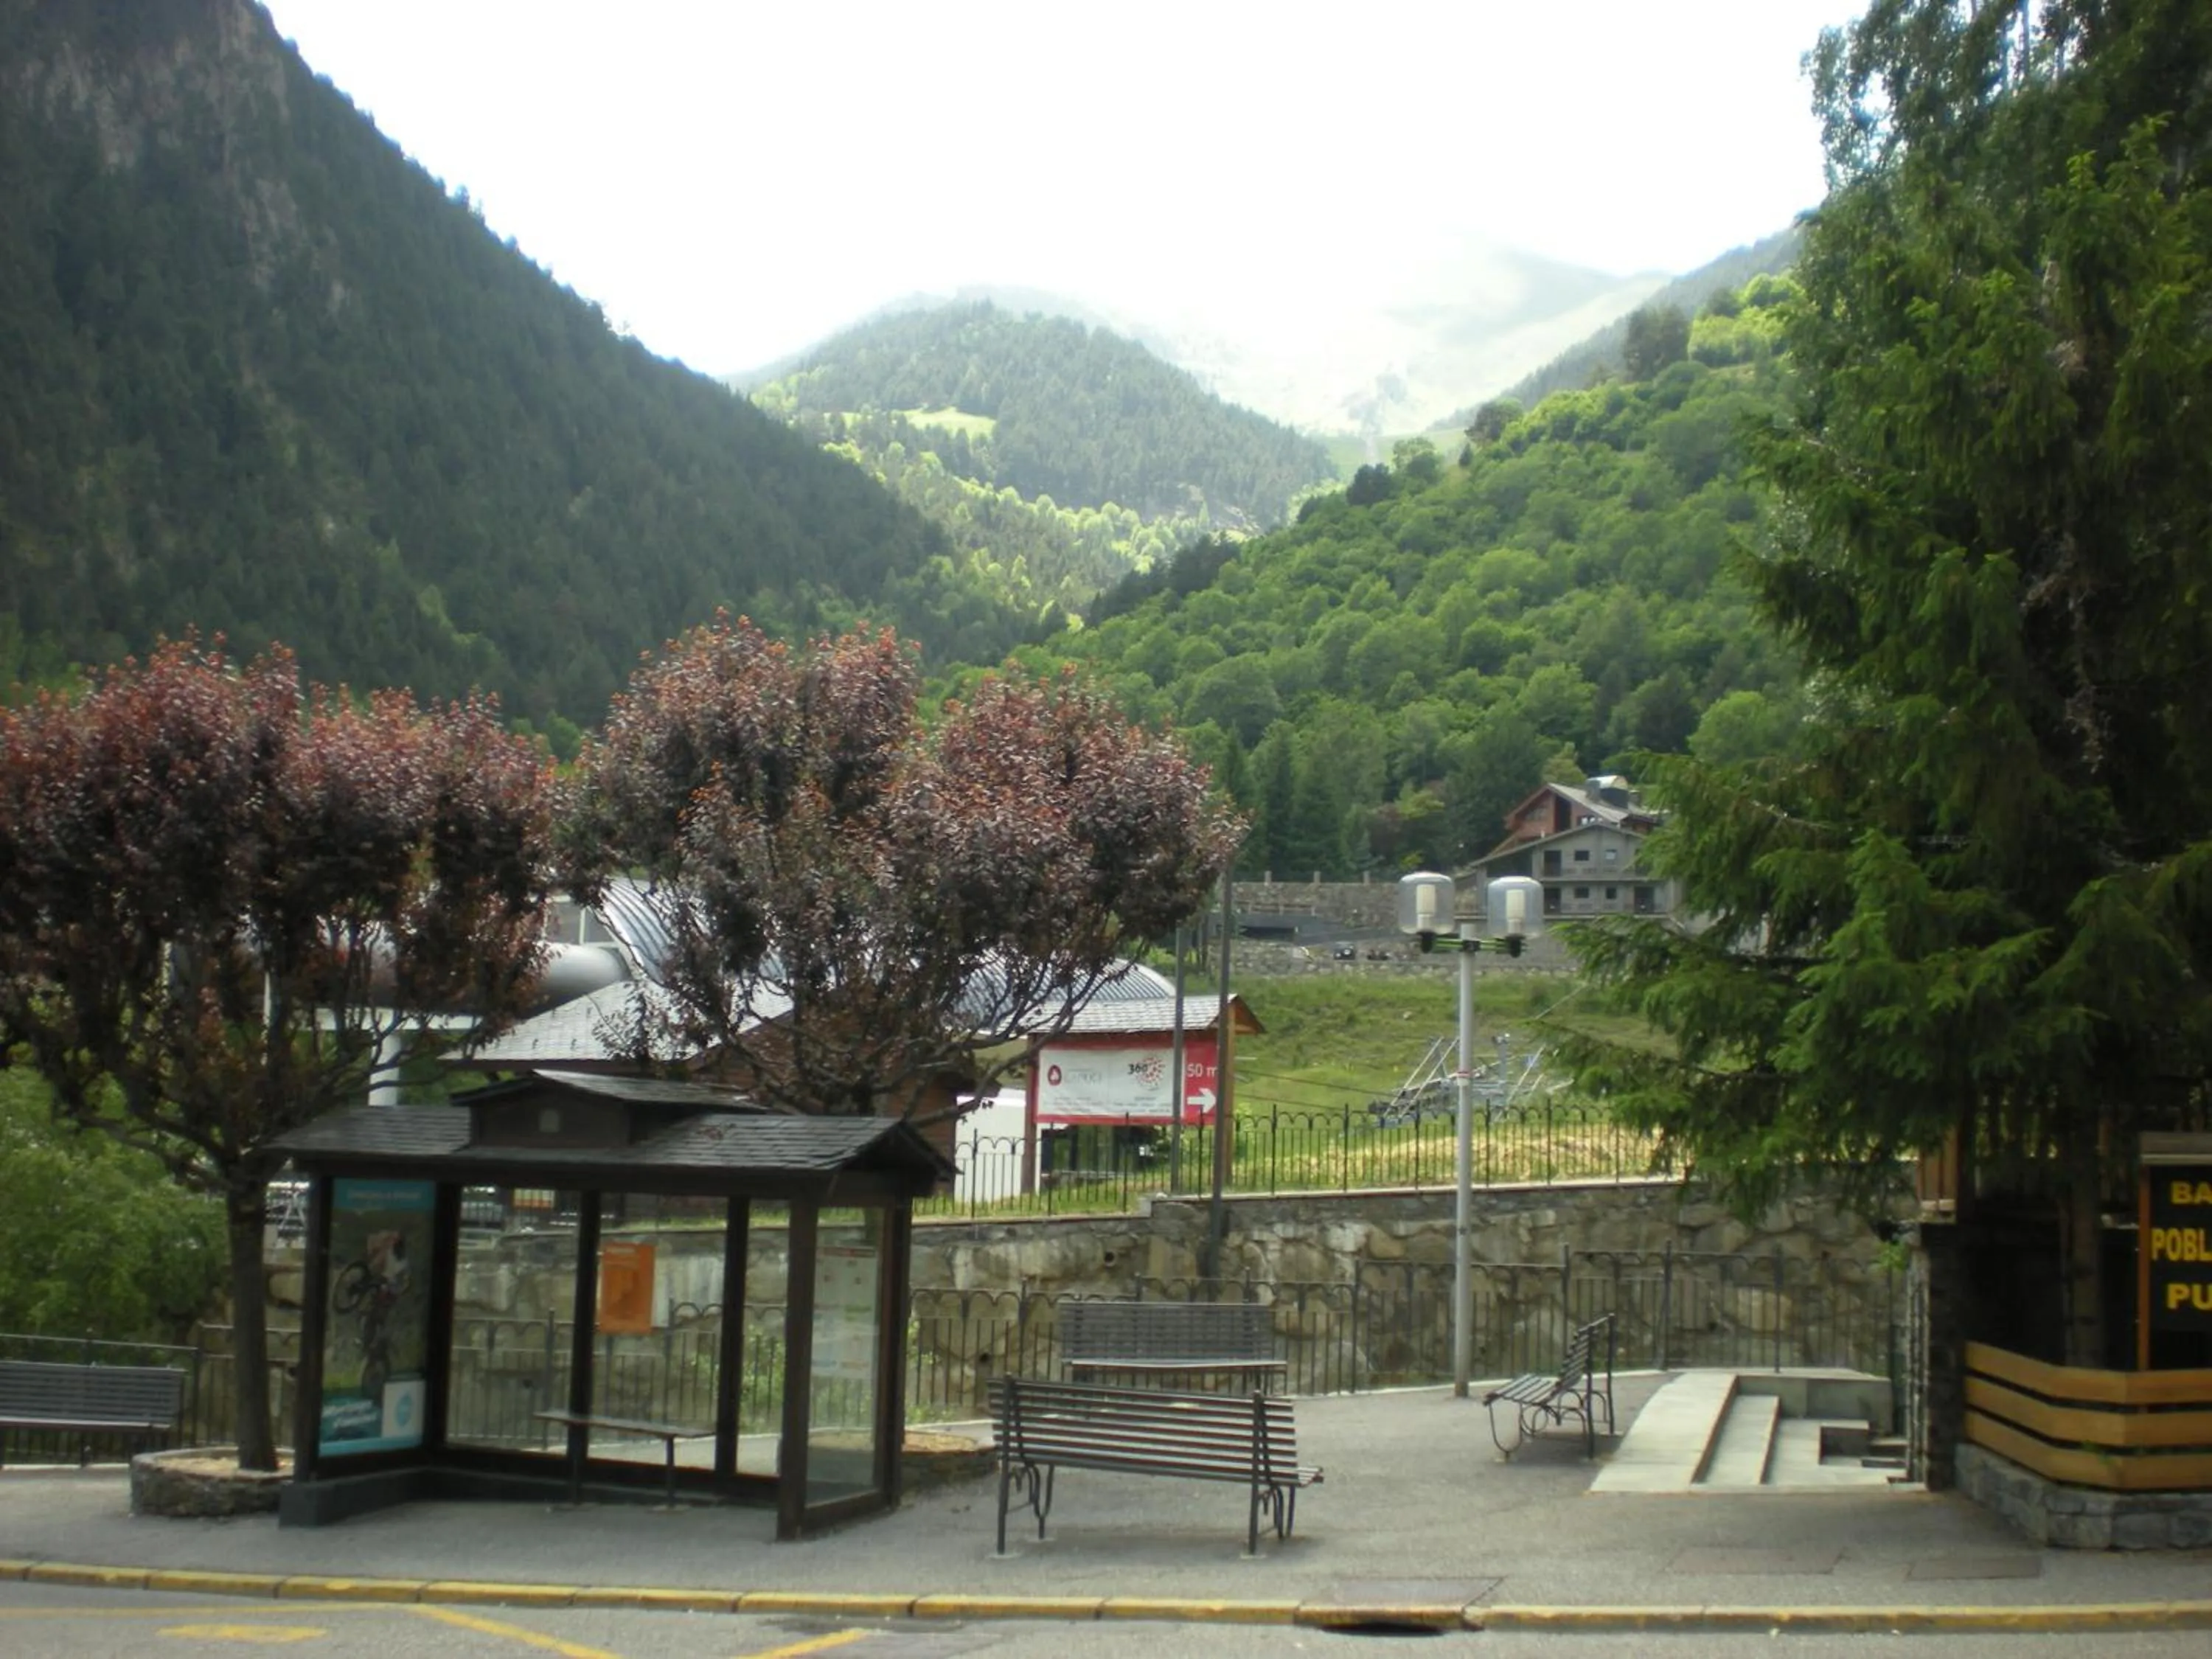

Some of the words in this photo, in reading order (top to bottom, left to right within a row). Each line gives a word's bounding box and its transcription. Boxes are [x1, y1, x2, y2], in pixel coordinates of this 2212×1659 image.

[1187, 1063, 1203, 1078] 50
[2171, 1180, 2212, 1205] BA
[2166, 1283, 2212, 1310] PU
